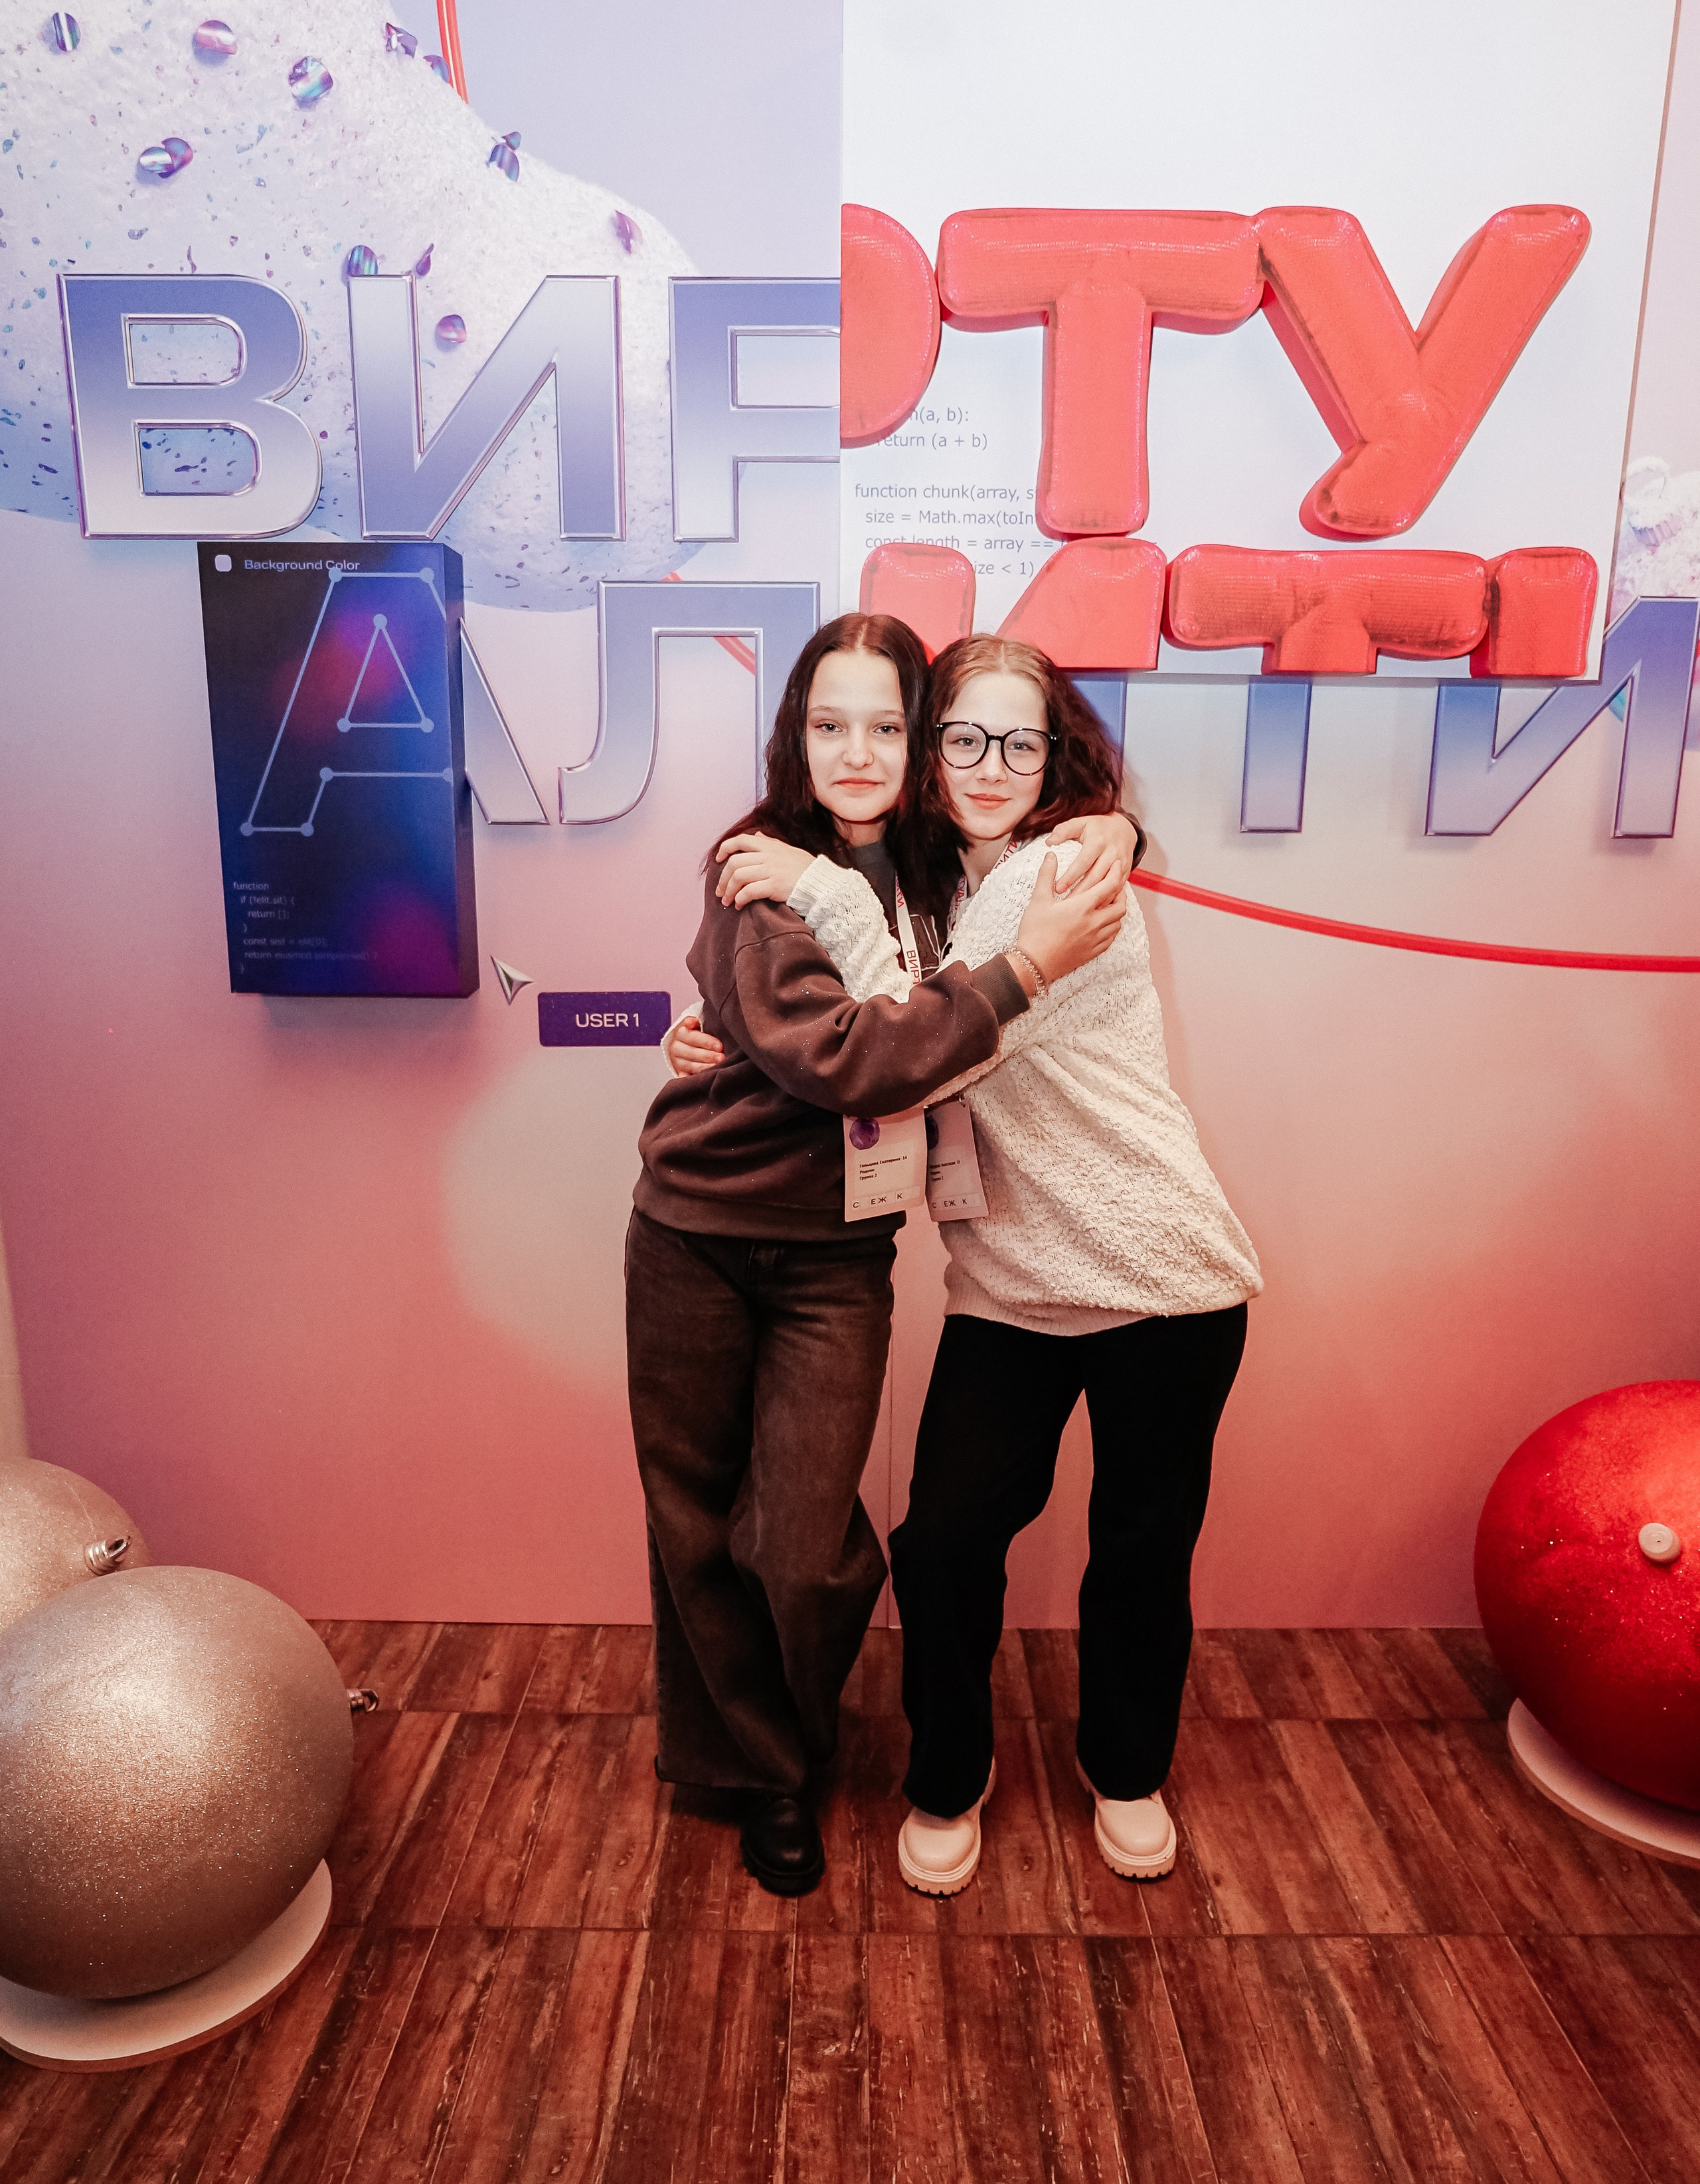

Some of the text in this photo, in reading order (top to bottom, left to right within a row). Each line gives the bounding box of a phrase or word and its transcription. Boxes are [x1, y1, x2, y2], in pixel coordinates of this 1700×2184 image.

[947, 406, 969, 424] b):
[932, 433, 947, 450] (a
[972, 433, 988, 450] b)
[855, 483, 917, 498] function
[923, 484, 1020, 503] chunk(array,
[865, 509, 894, 523] size
[984, 539, 1024, 552] array
[244, 559, 361, 572] Background Color
[974, 561, 995, 575] ize
[1020, 561, 1034, 578] 1)
[233, 881, 270, 890] function
[575, 1013, 639, 1028] USER 1
